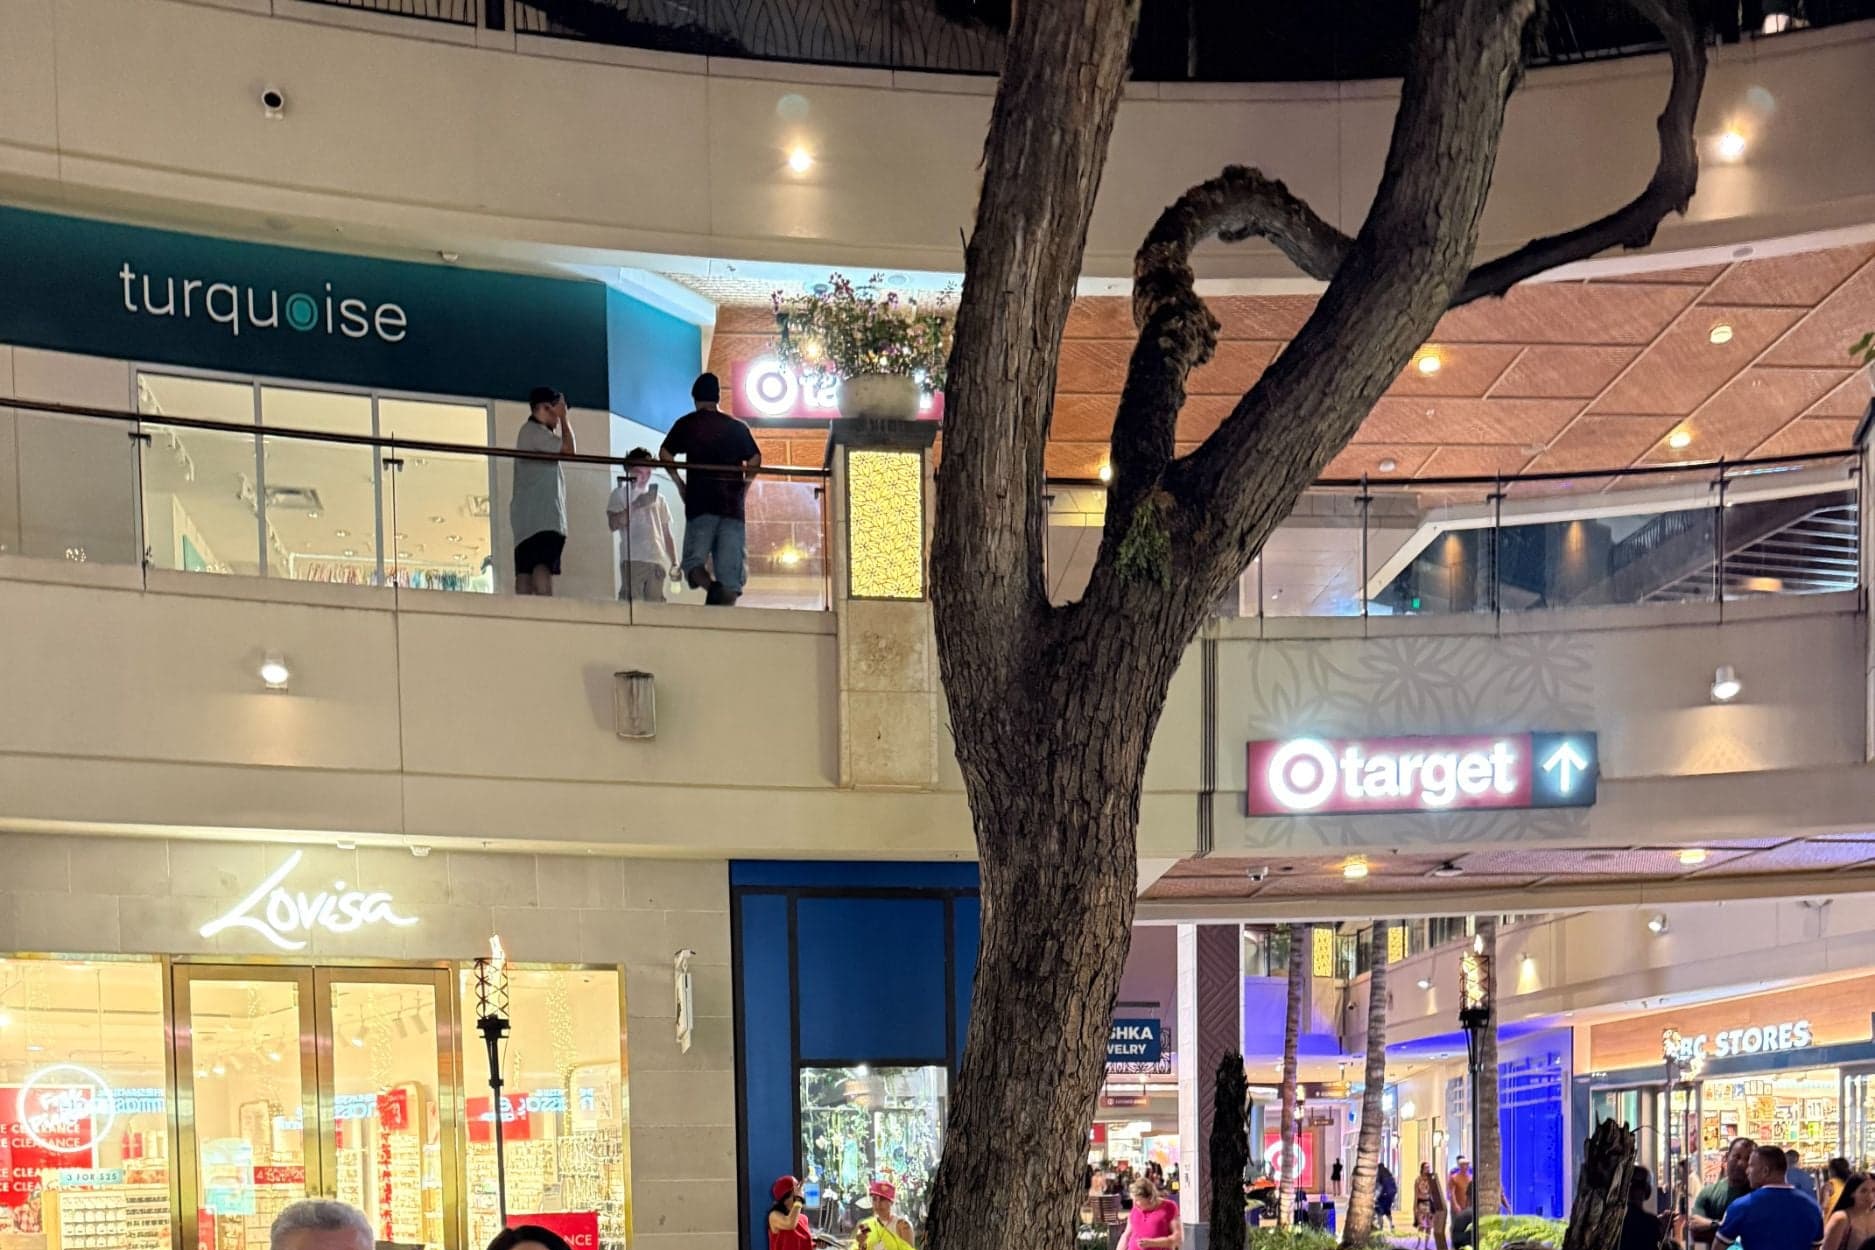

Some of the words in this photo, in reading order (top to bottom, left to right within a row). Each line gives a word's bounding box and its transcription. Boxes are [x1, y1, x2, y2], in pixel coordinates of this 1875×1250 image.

[119, 263, 408, 343] turquoise
[1341, 740, 1516, 806] target
[200, 850, 419, 950] Lovisa
[1715, 1020, 1812, 1057] STORES
